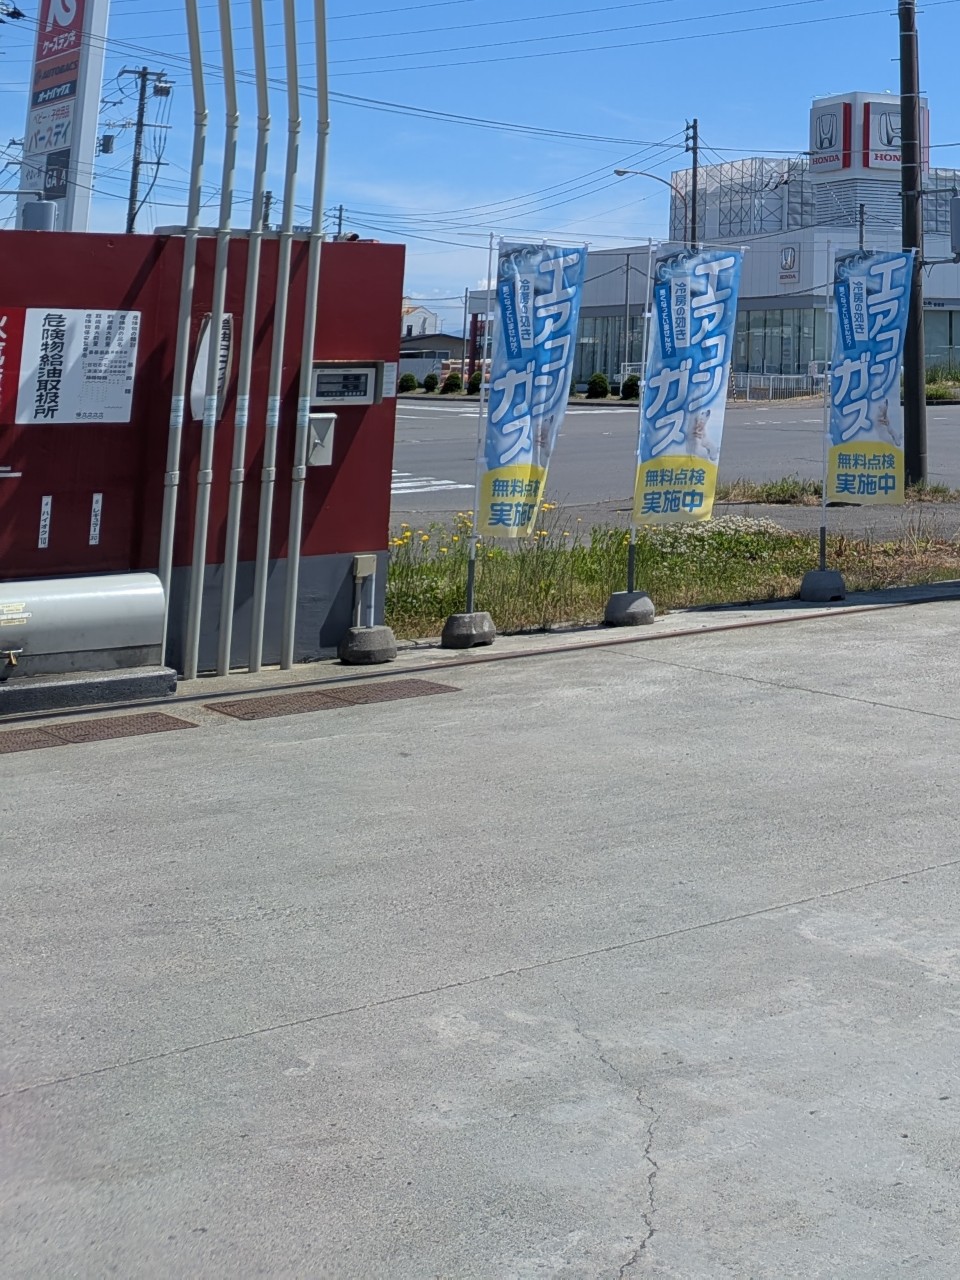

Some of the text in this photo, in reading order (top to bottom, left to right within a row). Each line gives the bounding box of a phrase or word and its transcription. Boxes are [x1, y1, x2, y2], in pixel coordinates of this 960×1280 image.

[28, 120, 71, 153] バースデイ
[874, 153, 902, 162] HON
[812, 154, 840, 165] HONDA
[674, 281, 687, 341] 冷房の効き
[852, 280, 864, 335] 冷房の効き
[867, 256, 907, 400] エアコン
[534, 252, 580, 417] エアコン
[689, 256, 736, 412] エアコン
[33, 313, 67, 419] 危険物給油取扱所
[491, 360, 535, 463] ガス
[646, 358, 692, 456] ガス
[834, 351, 872, 441] ガス
[645, 468, 706, 487] 無料点検
[837, 452, 896, 470] 無料点検
[641, 489, 704, 514] 実施中
[835, 472, 896, 496] 実施中
[41, 510, 50, 536] ハイオク
[92, 507, 100, 533] レギュラー
